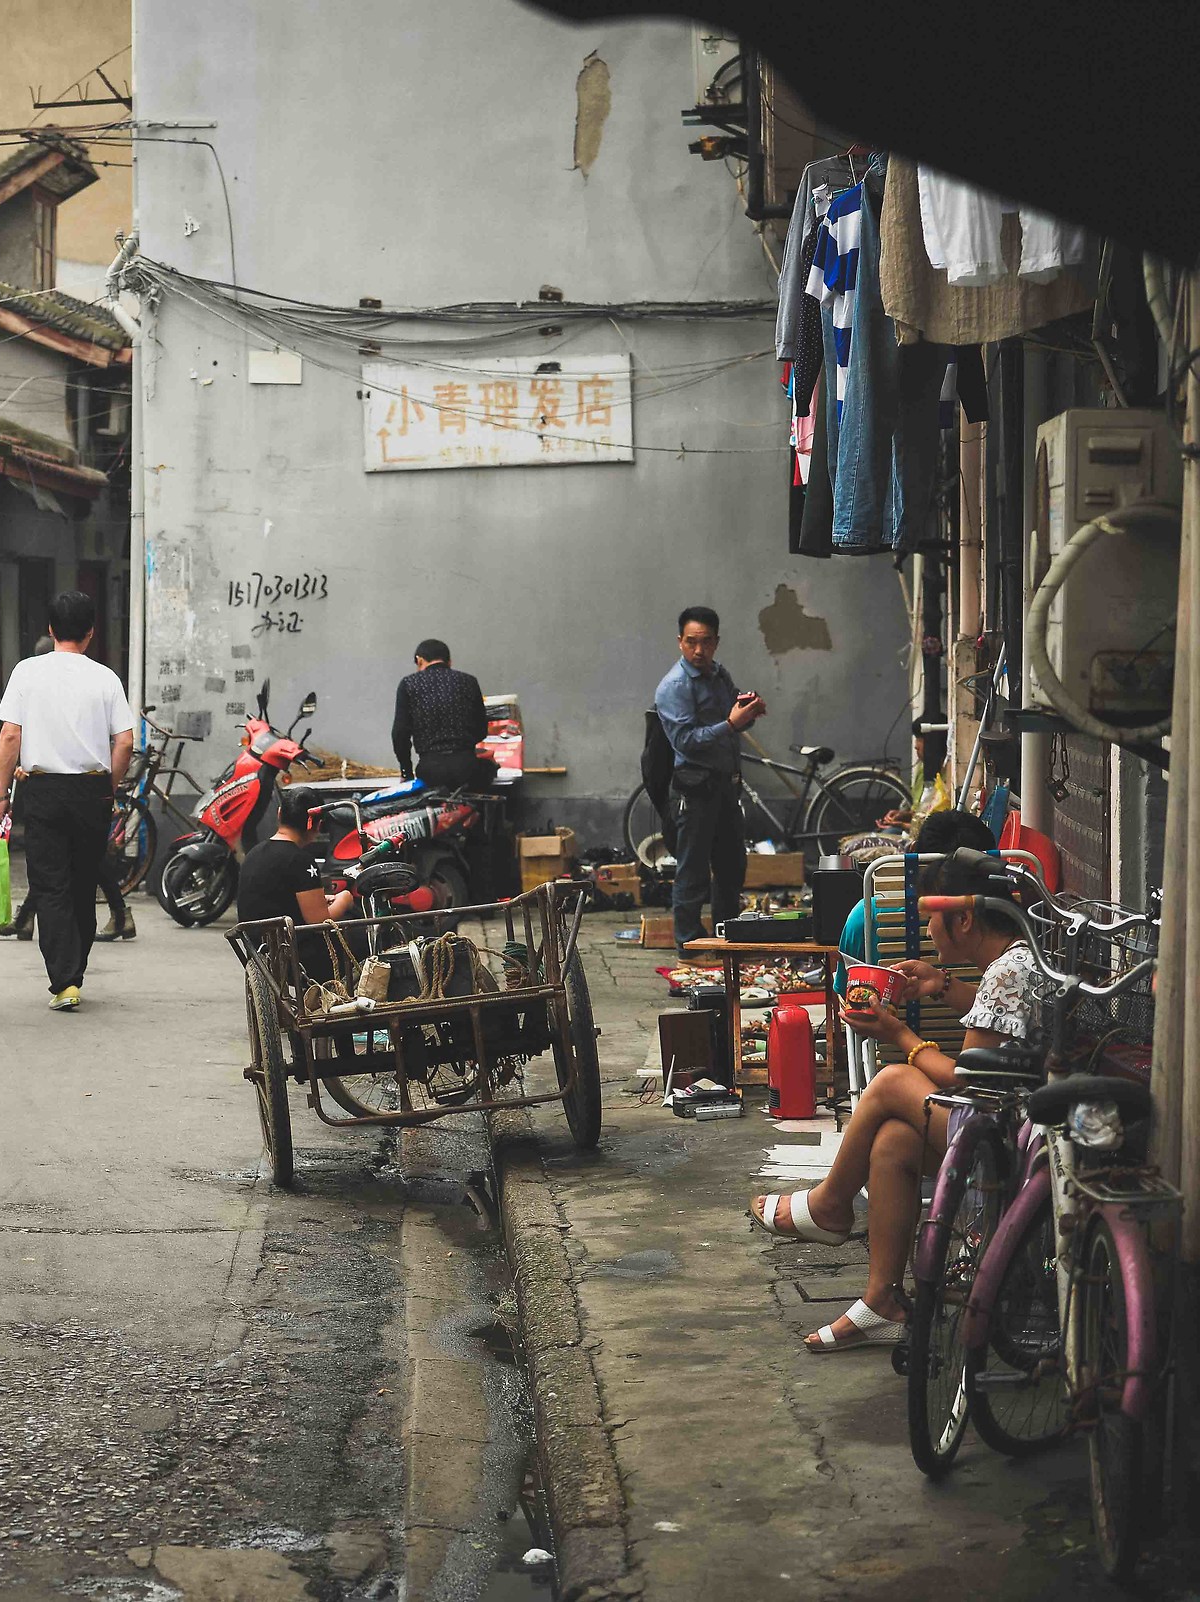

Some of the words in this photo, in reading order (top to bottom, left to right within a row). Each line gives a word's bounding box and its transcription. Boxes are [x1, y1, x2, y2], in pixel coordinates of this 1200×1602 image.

[386, 373, 615, 437] 小青理发店
[227, 572, 329, 608] 15170301313
